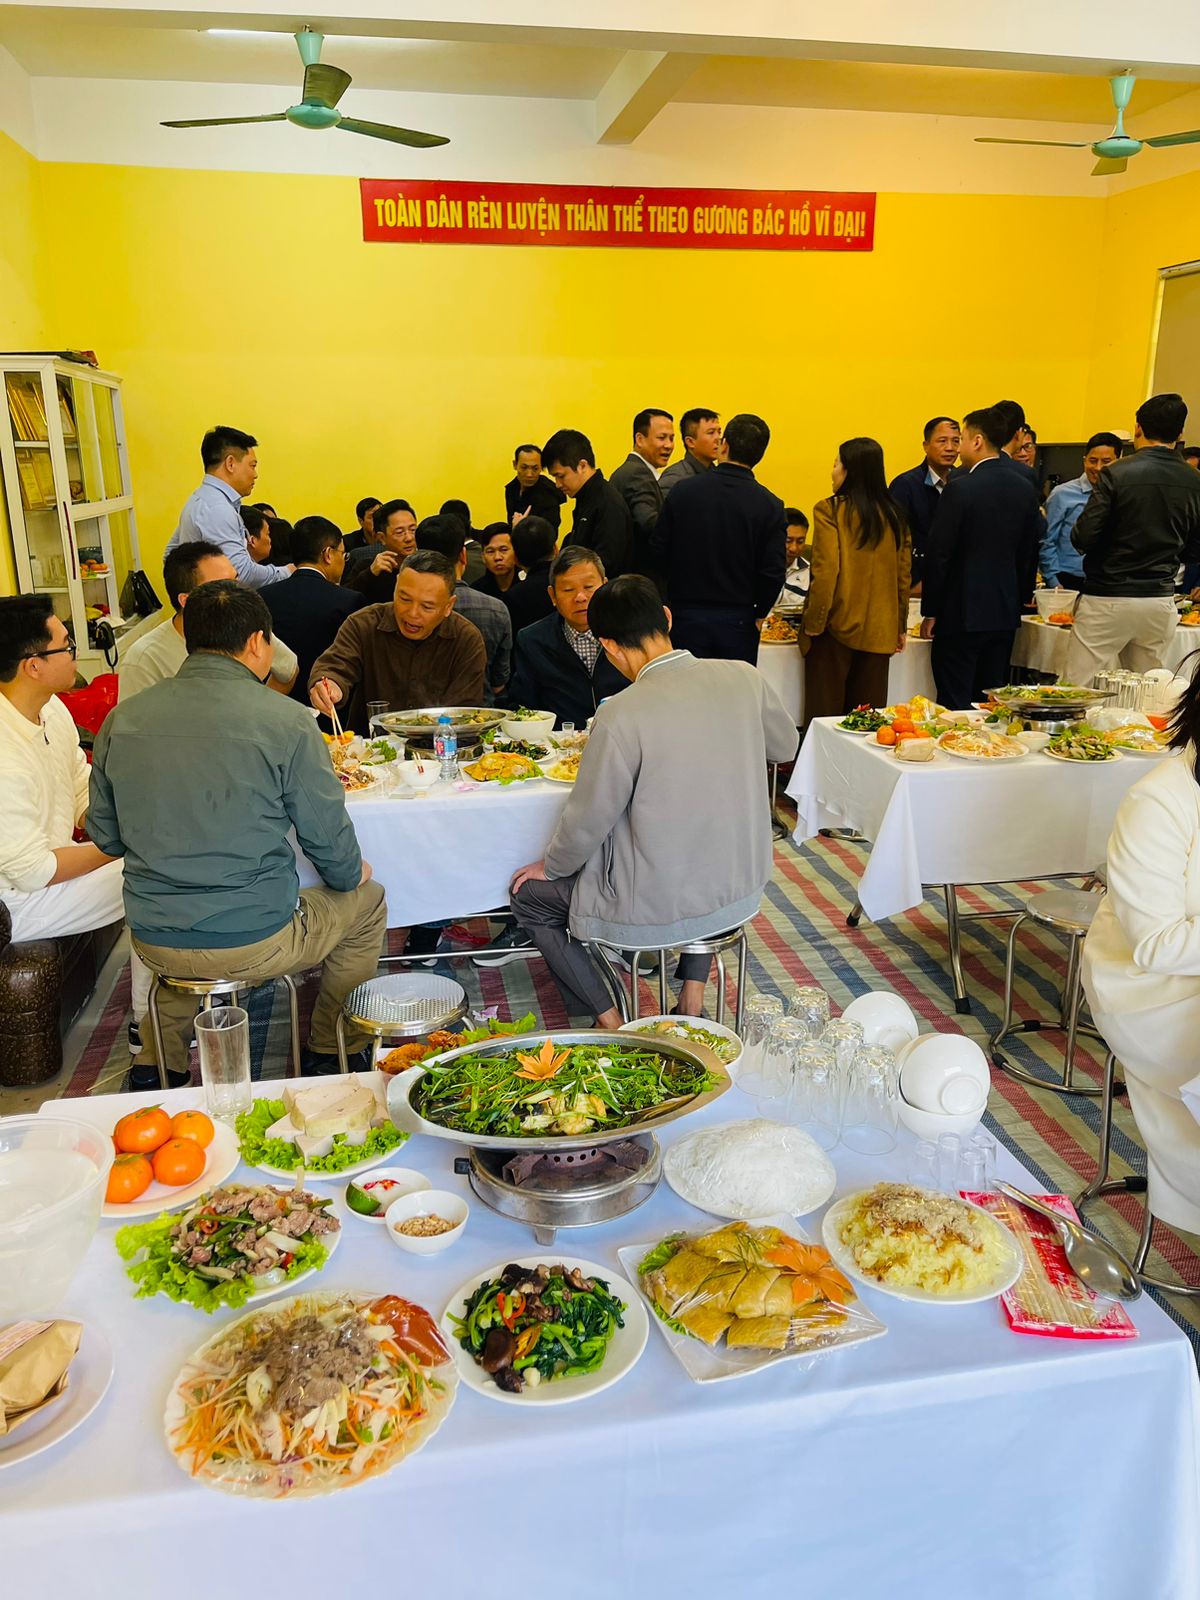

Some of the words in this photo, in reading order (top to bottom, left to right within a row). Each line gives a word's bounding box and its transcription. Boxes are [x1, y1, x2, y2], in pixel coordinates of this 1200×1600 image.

[374, 193, 421, 228] TOÀN
[426, 194, 462, 229] DÂN
[468, 195, 502, 229] RÈN
[507, 197, 560, 236] LUYỆN
[565, 198, 608, 231] THÂN
[613, 194, 644, 232] THỂ
[648, 203, 688, 233] THEO
[693, 205, 748, 235] GƯƠNG
[752, 202, 784, 235] BÁC
[789, 200, 810, 236] HỒ
[815, 205, 830, 236] VĨ
[834, 210, 866, 243] ĐẠI!
